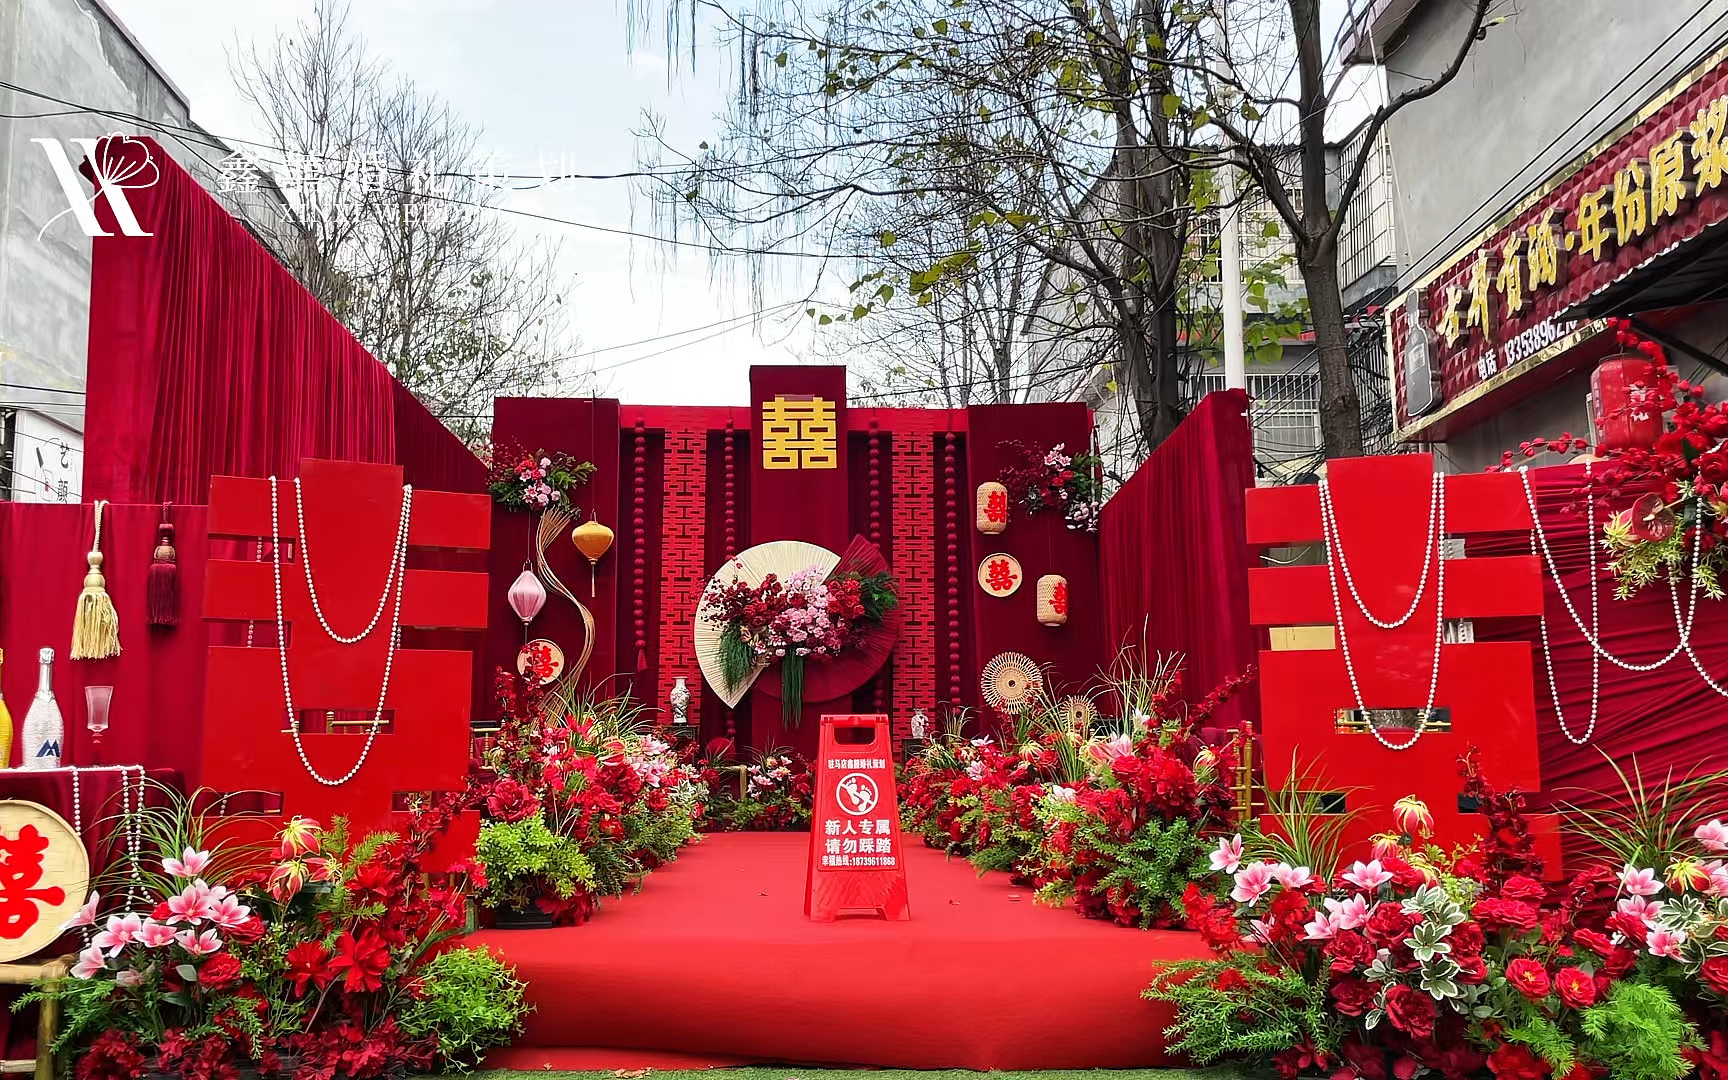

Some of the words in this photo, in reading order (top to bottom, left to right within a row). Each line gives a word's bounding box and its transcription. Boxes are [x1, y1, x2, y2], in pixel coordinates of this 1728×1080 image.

[1477, 348, 1498, 381] 电话
[824, 818, 891, 836] 新人专属
[824, 837, 892, 855] 请勿踩踏
